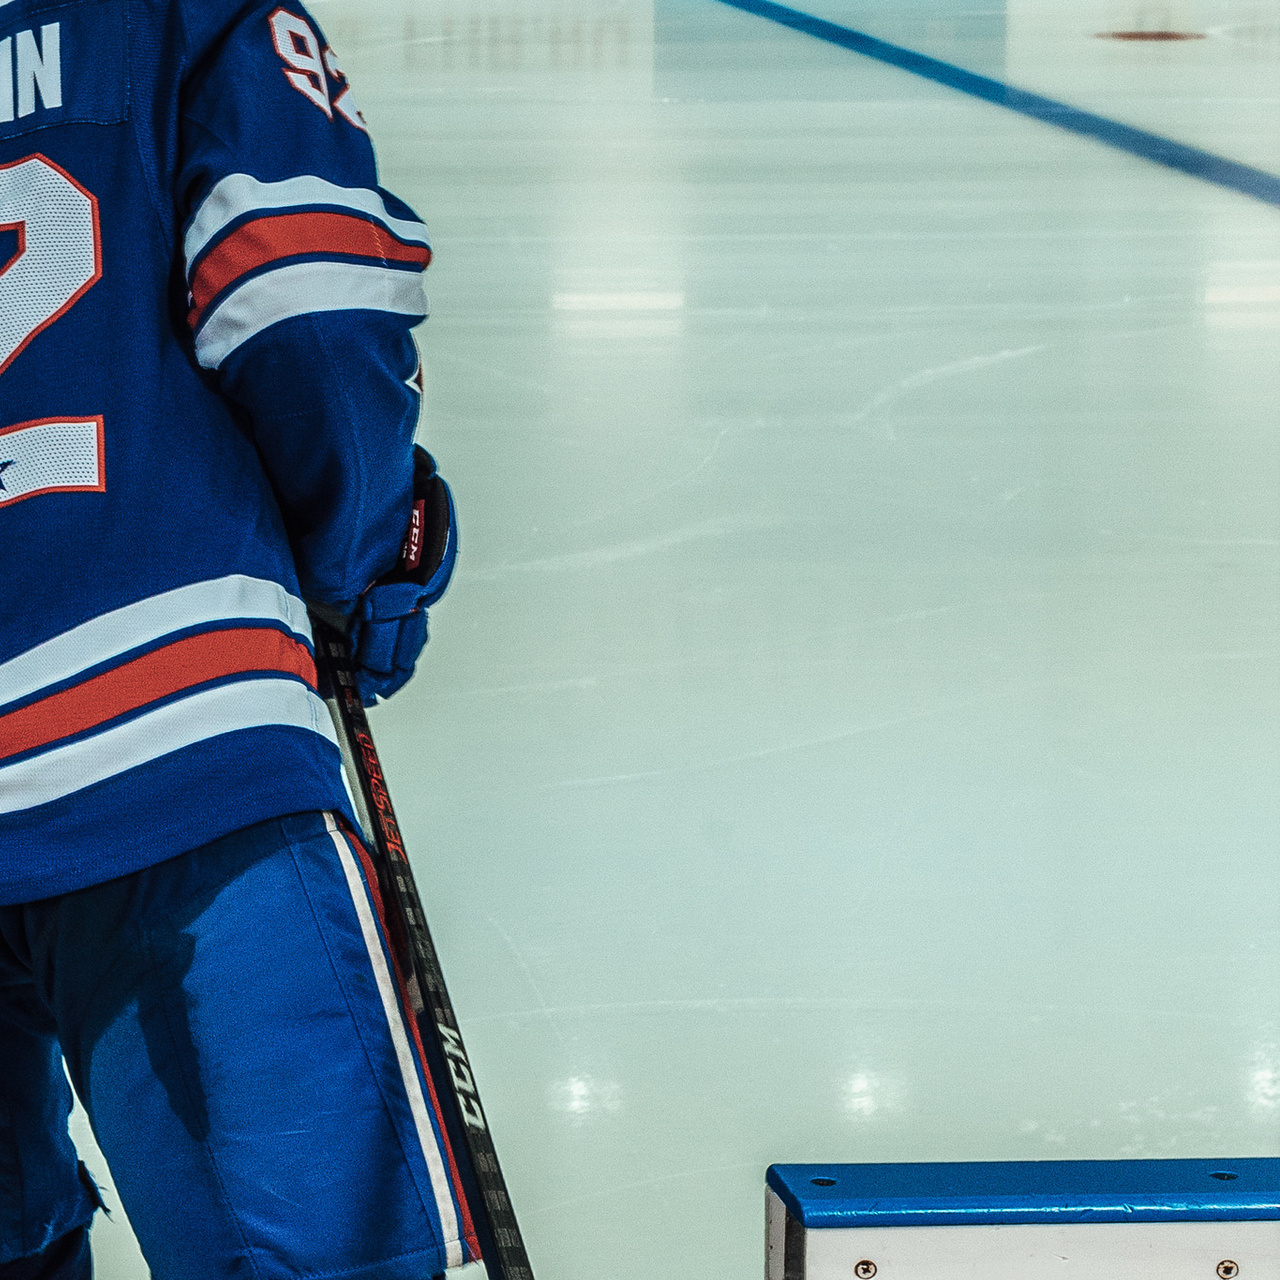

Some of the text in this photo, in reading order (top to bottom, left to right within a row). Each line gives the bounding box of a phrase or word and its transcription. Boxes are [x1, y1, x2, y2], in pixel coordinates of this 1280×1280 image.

[408, 508, 420, 562] CCM
[356, 731, 408, 867] JETSPEED
[437, 1022, 486, 1131] CCM
